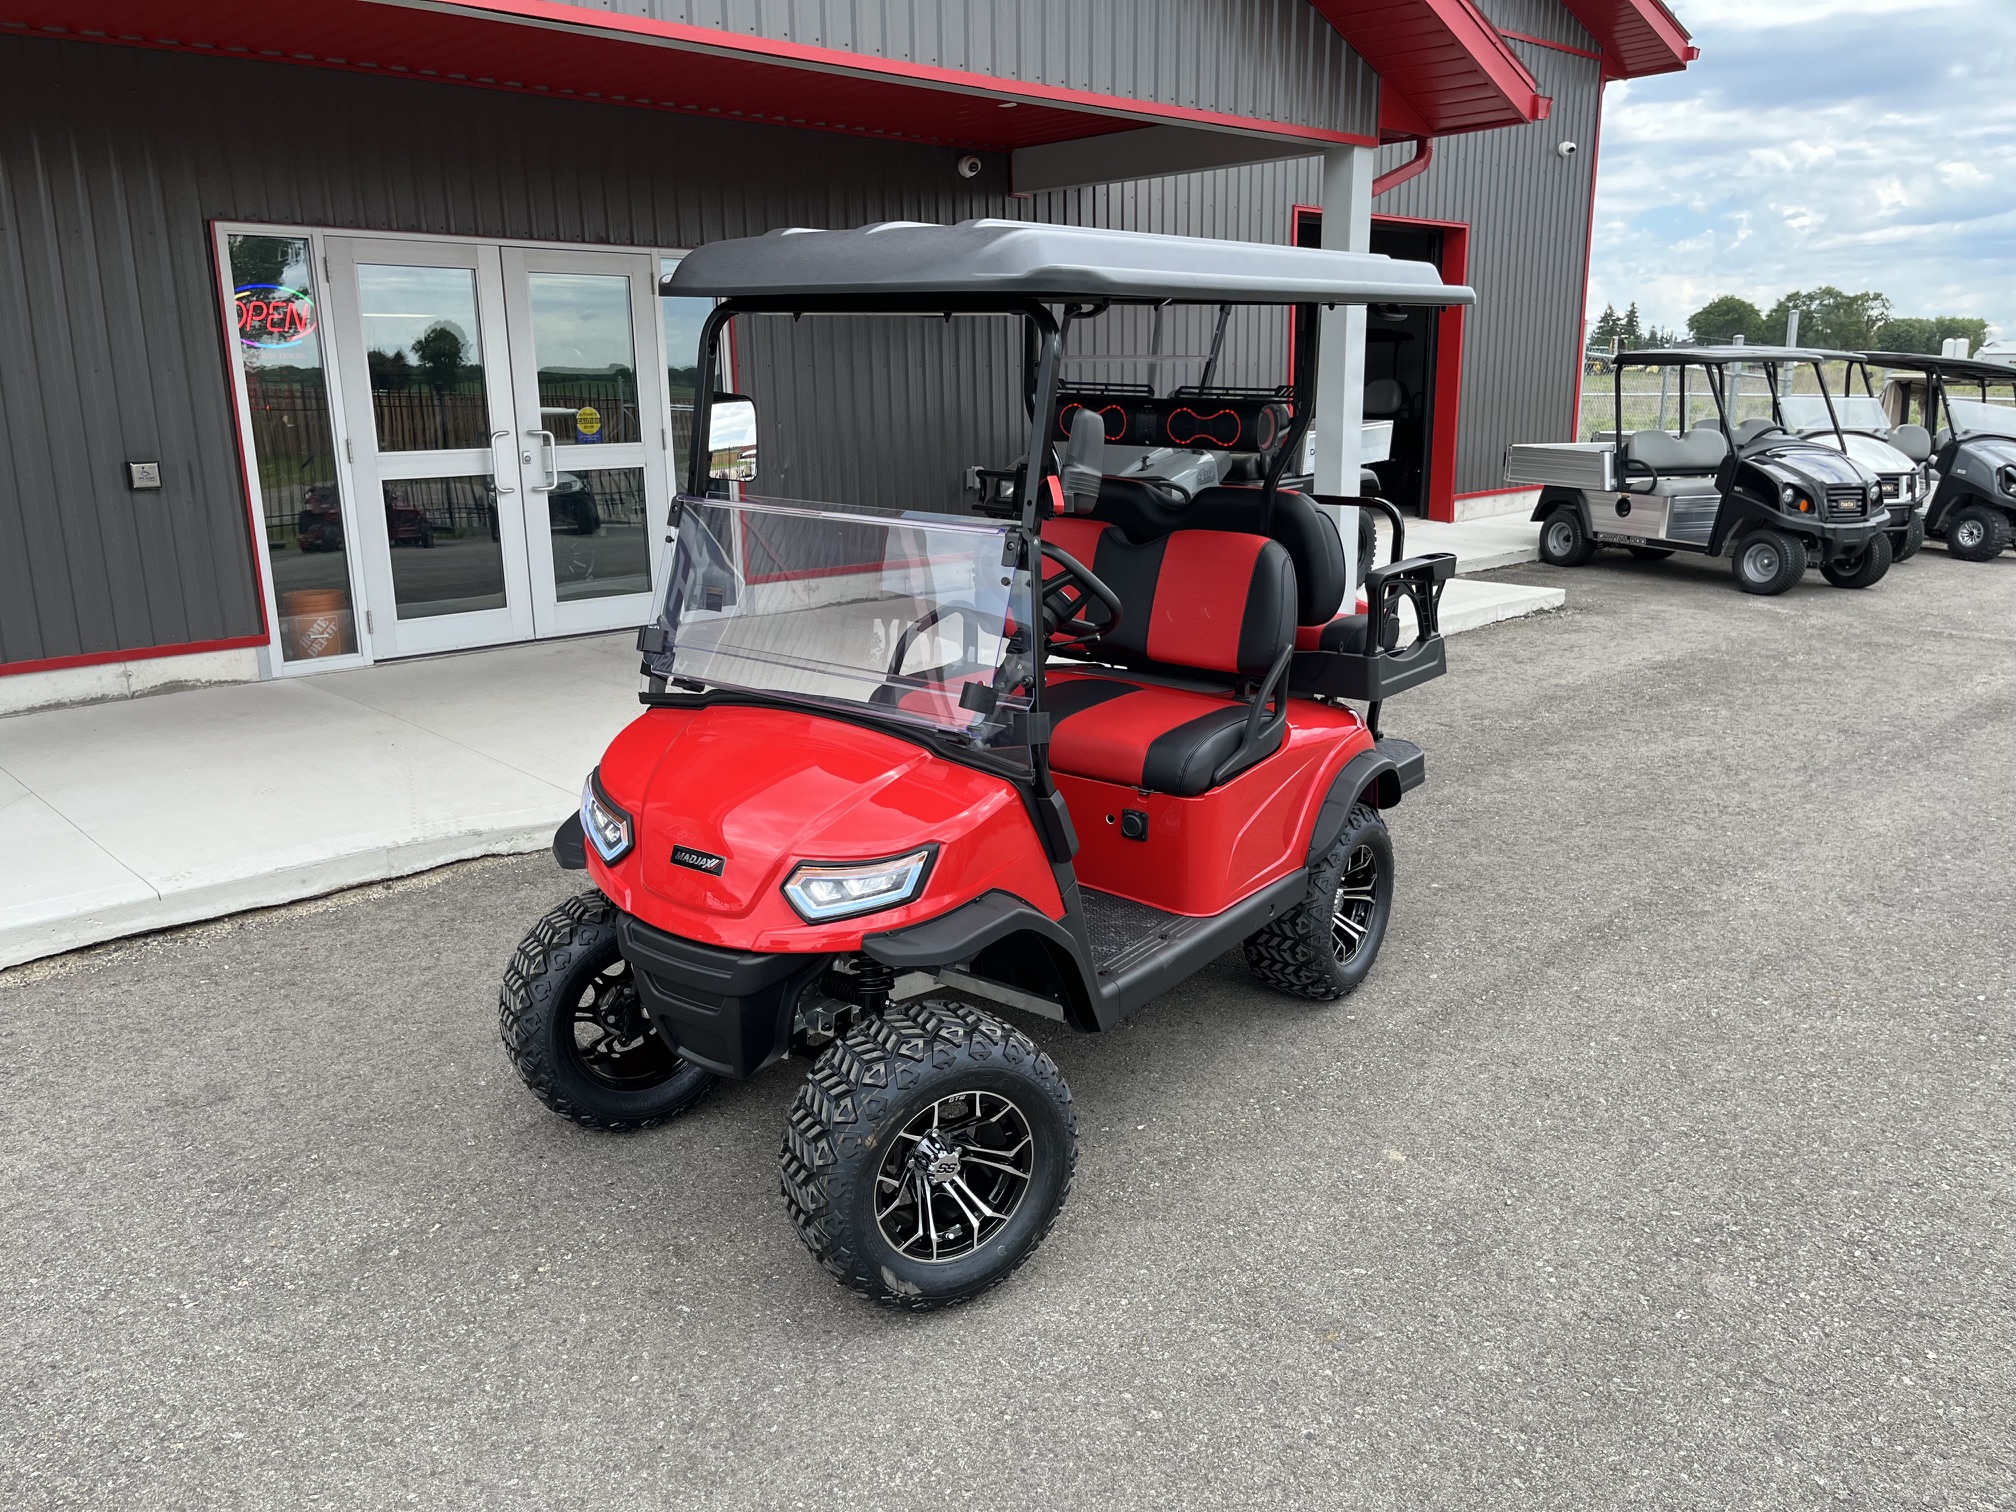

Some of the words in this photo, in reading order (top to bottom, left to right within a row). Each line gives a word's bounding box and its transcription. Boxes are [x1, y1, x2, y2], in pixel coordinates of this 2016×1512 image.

[235, 301, 309, 332] OPEN
[1197, 465, 1215, 481] 4x4
[300, 617, 329, 649] HOME
[307, 621, 337, 657] DEPOT
[674, 851, 719, 869] MADJAX
[936, 1162, 957, 1174] SS
